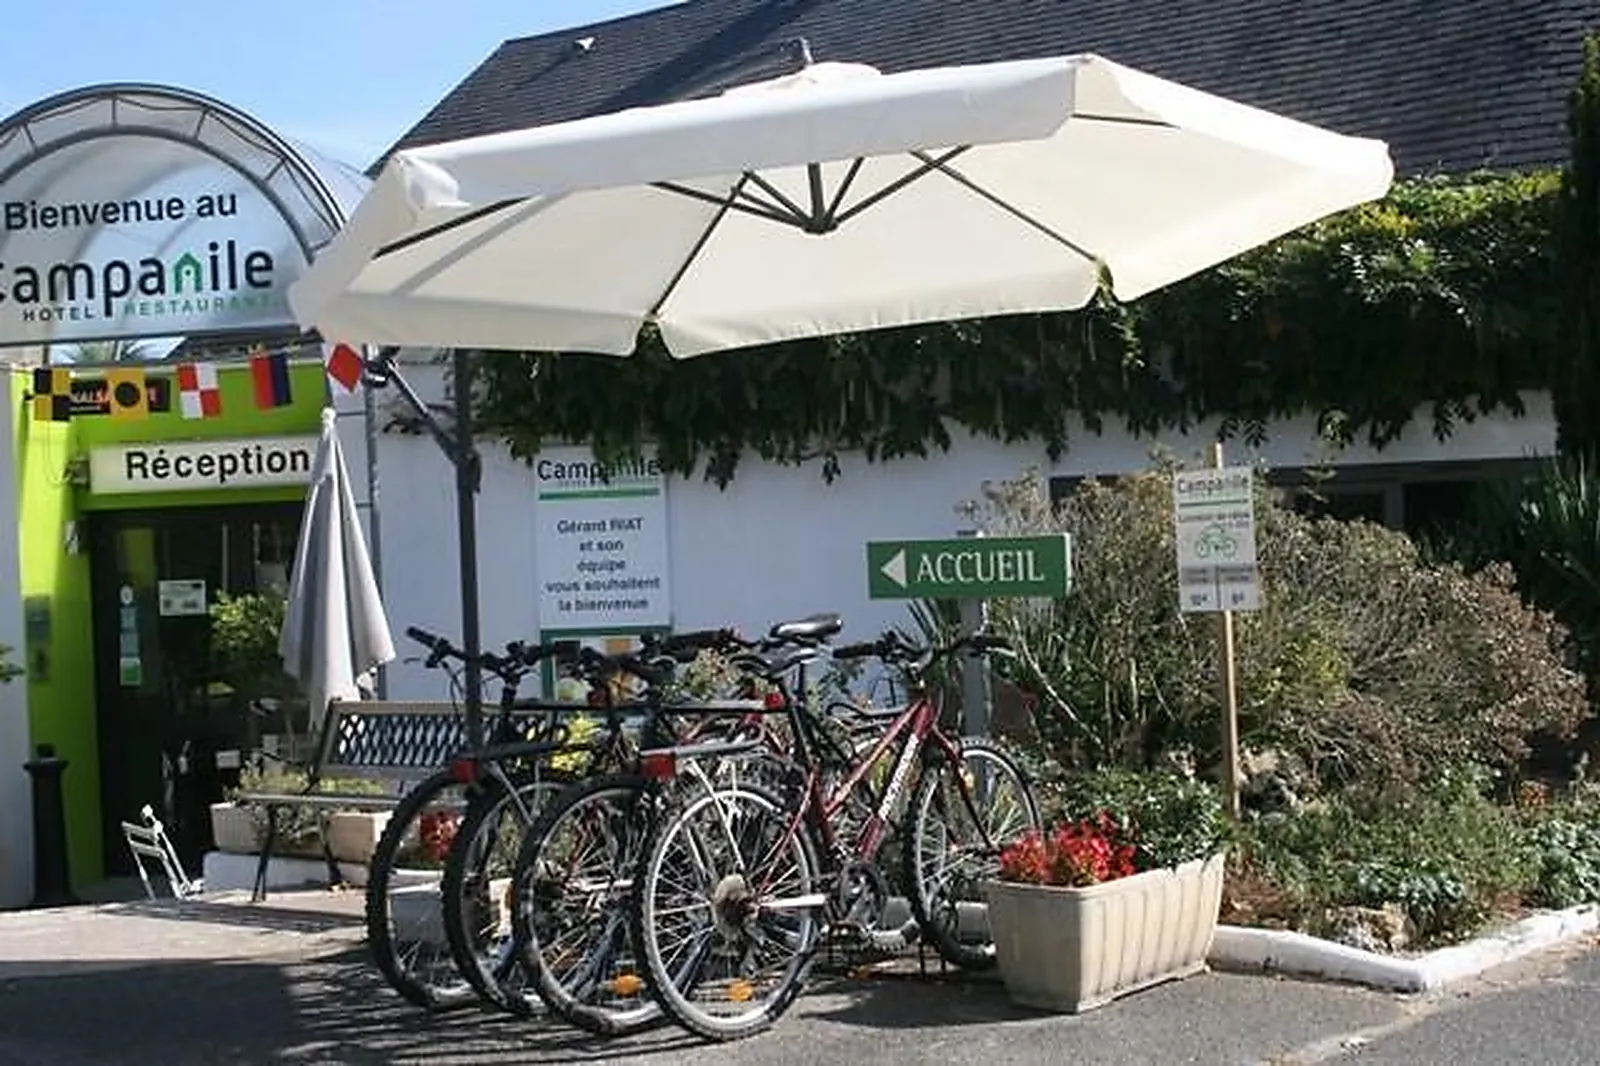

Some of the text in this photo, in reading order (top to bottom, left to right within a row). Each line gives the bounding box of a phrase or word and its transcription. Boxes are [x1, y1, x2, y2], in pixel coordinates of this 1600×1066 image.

[5, 192, 237, 231] Bienvenue au
[0, 239, 274, 317] ampanile
[22, 305, 95, 321] HOTEL
[125, 445, 310, 484] Réception
[580, 540, 625, 552] et son
[917, 549, 1046, 584] ACCUEIL
[545, 580, 581, 593] vous
[575, 599, 649, 612] bienvenue
